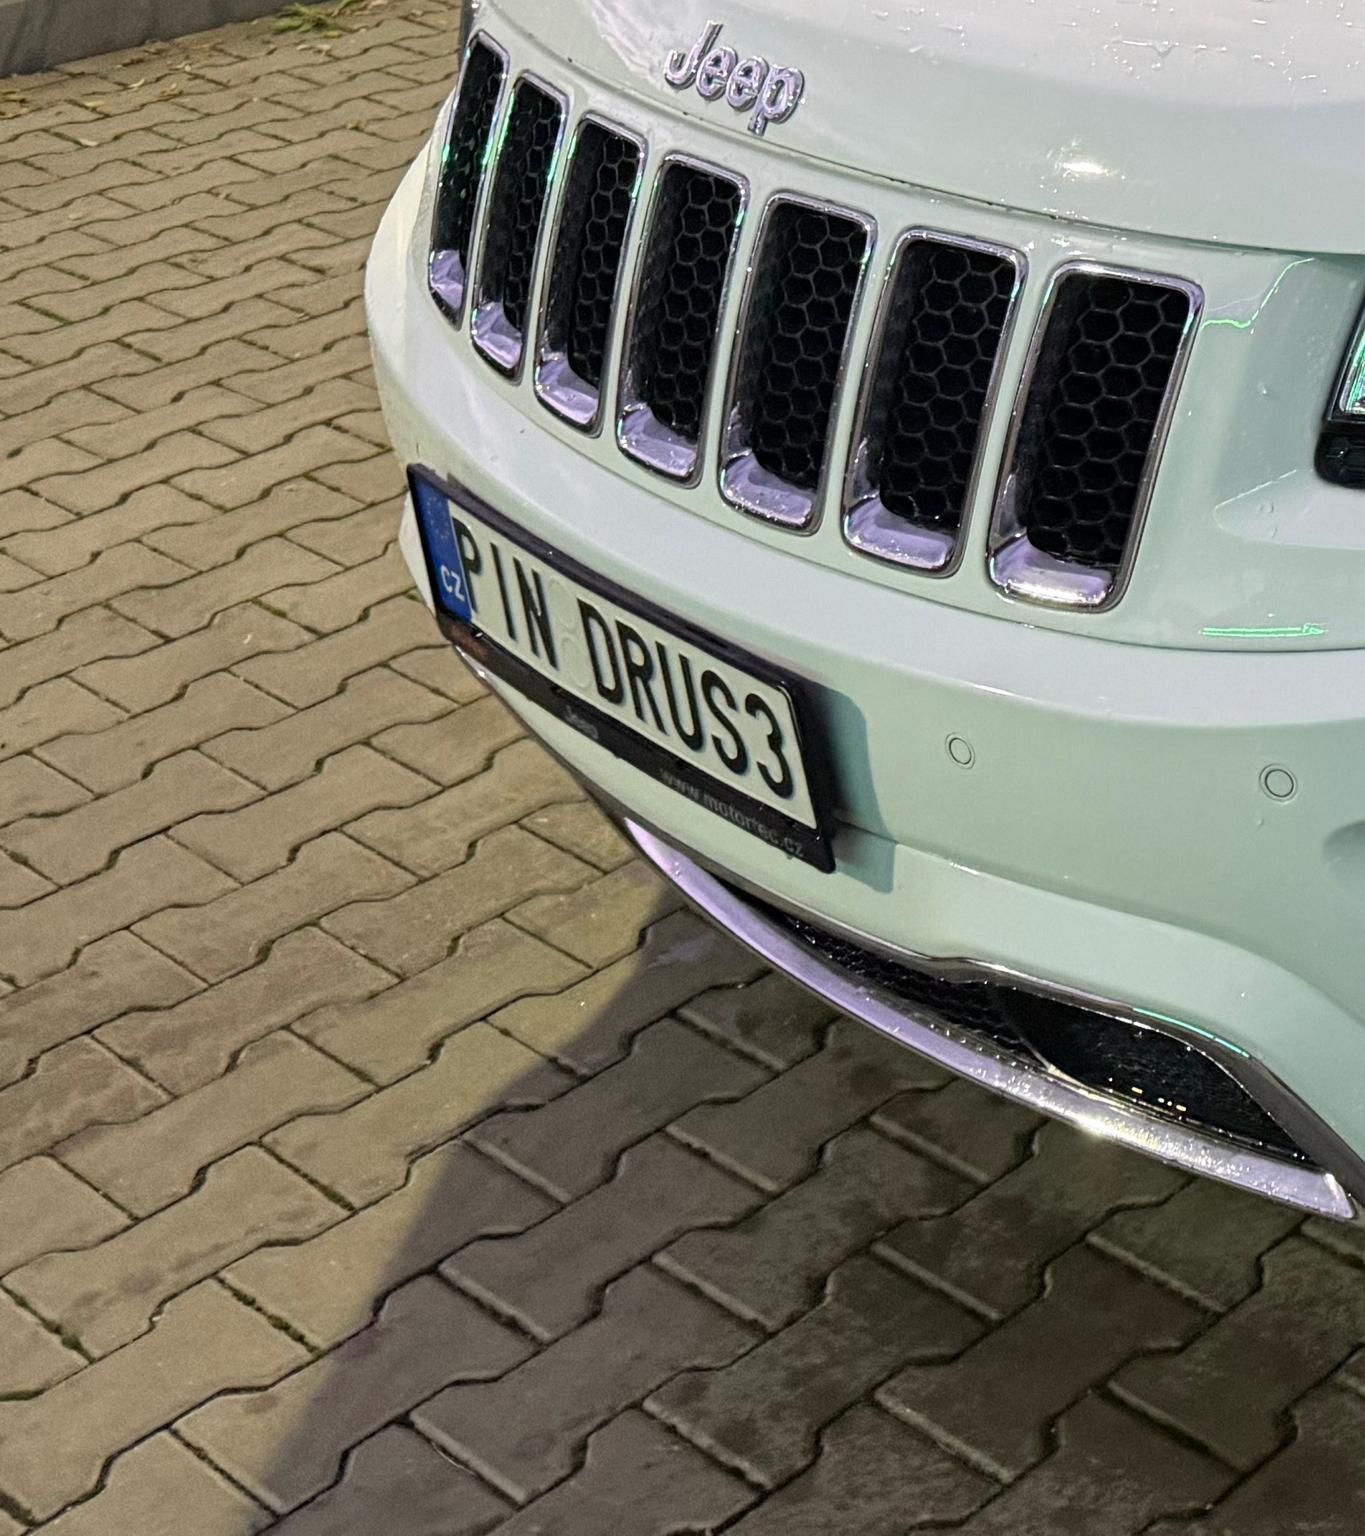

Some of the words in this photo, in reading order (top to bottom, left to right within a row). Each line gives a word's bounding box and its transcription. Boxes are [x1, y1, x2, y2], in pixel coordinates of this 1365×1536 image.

[664, 19, 805, 137] Jeep
[440, 564, 466, 602] CZ
[577, 596, 794, 800] DRUS3
